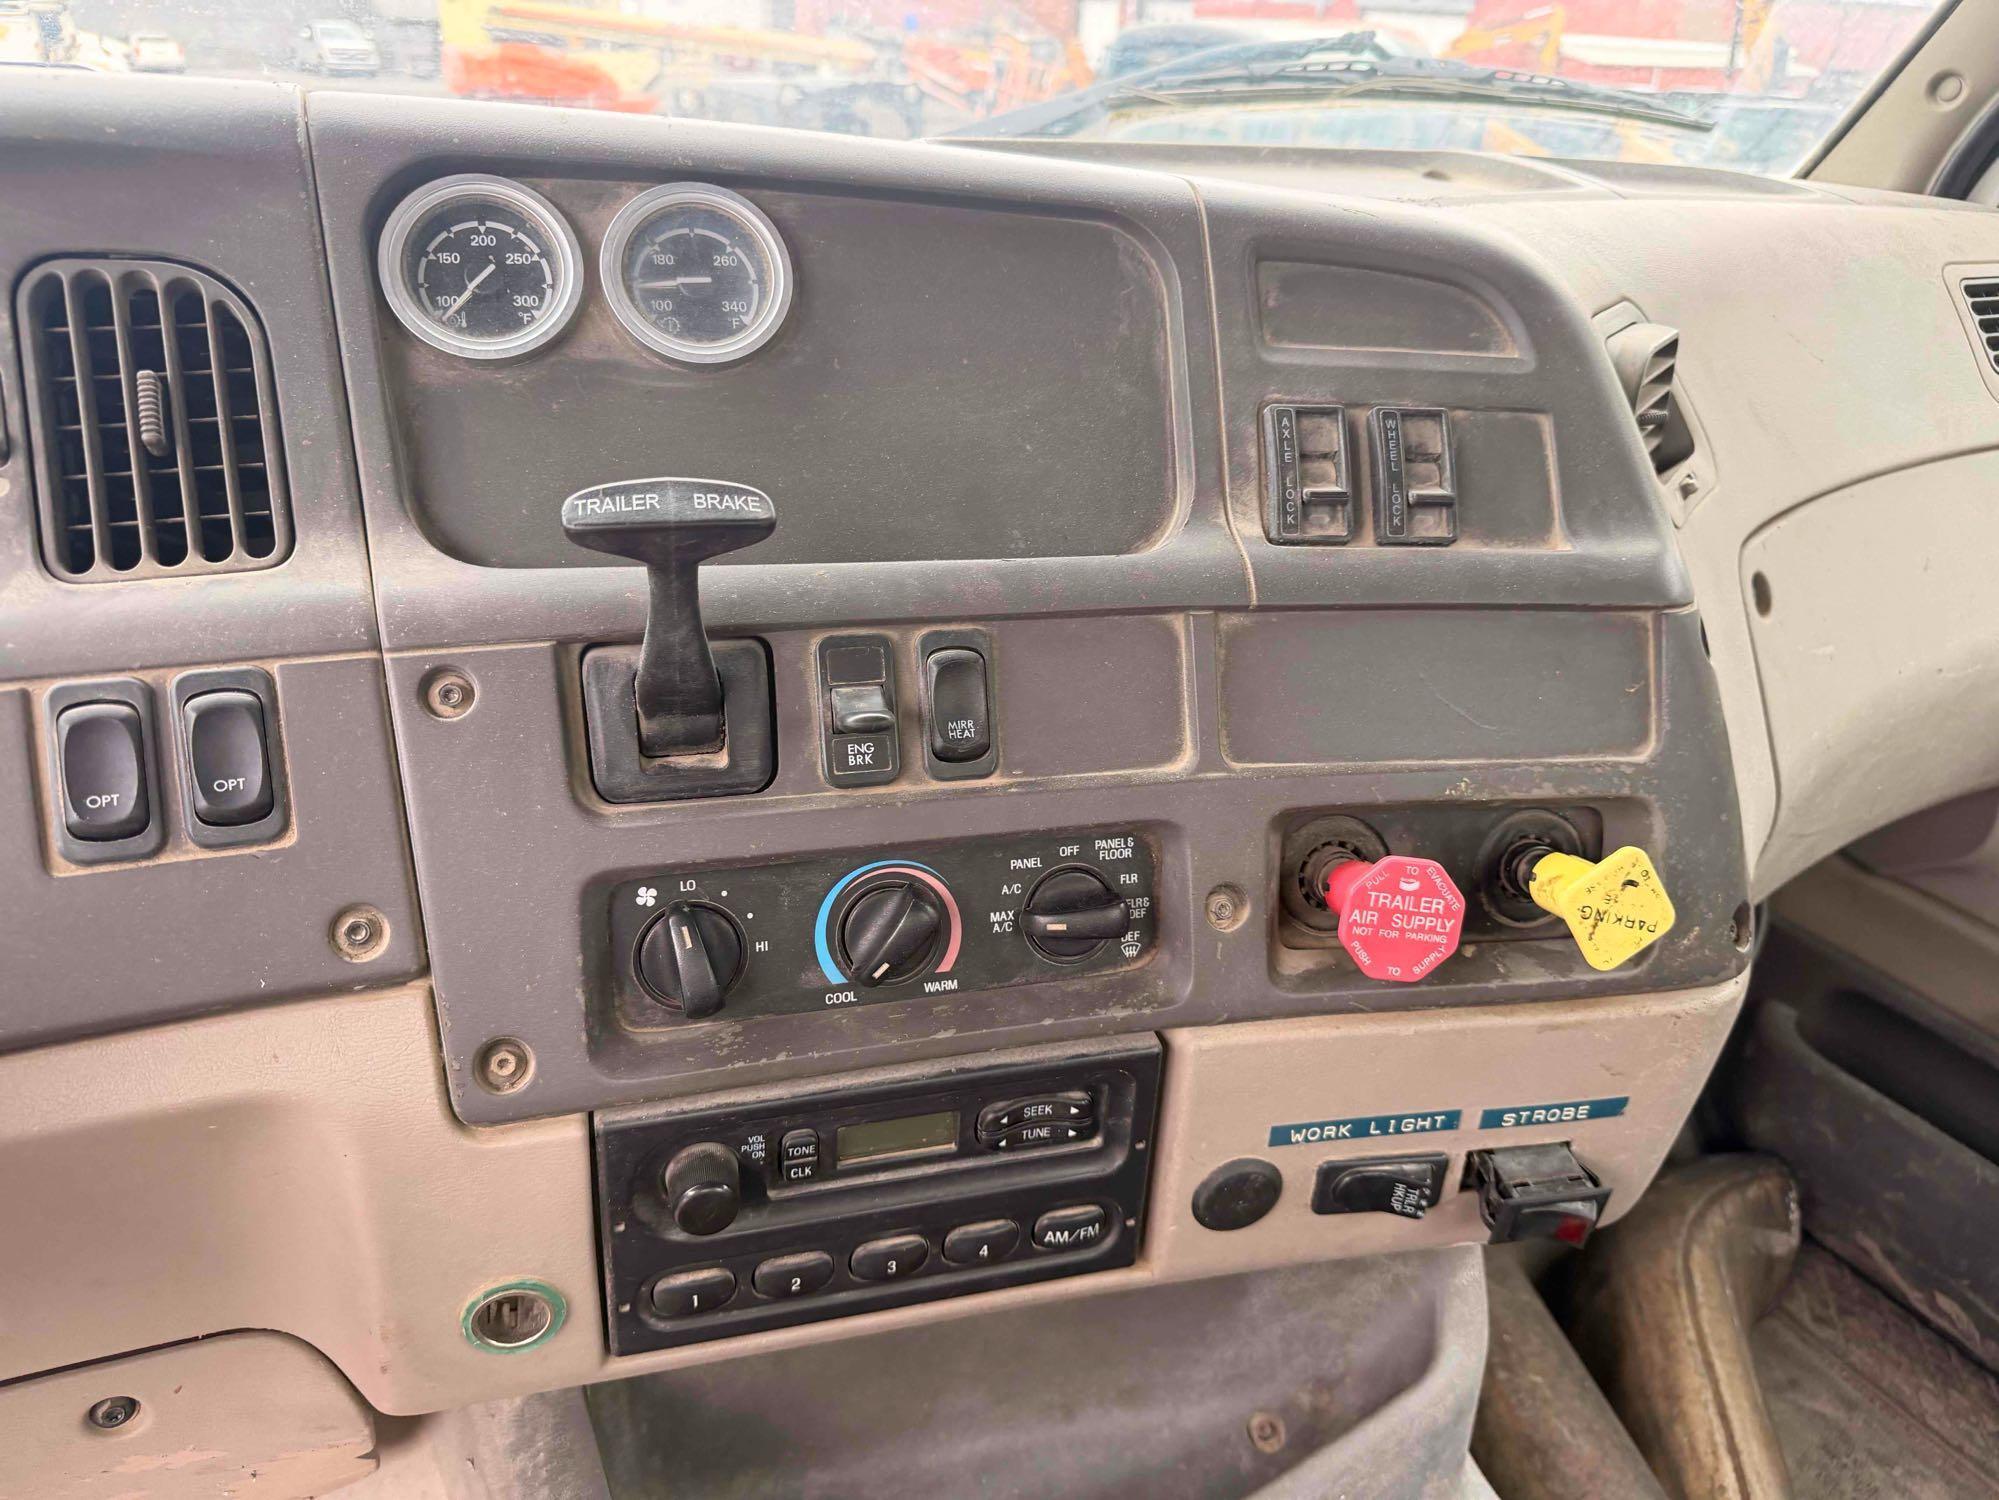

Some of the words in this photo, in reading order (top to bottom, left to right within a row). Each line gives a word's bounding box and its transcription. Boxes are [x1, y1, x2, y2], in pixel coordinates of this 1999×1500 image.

[470, 235, 497, 247] 200
[437, 252, 460, 264] 150
[505, 253, 531, 265] 250
[652, 254, 674, 265] 180
[713, 256, 738, 267] 260
[436, 295, 460, 307] 100
[513, 295, 539, 307] 300
[651, 300, 673, 311] 100
[722, 301, 747, 313] 340
[1281, 417, 1293, 463] AXLE
[1385, 419, 1399, 472] WHEEL
[1392, 483, 1401, 527] LOCK
[574, 494, 660, 516] TRAILER
[693, 493, 763, 512] BRAKE
[1286, 477, 1296, 525] LOCK
[948, 720, 974, 730] MIRR
[948, 729, 976, 739] HEAT
[847, 743, 875, 755] ENG
[848, 754, 874, 766] BRK
[213, 777, 246, 793] OPT
[86, 794, 120, 809] OPT
[1095, 838, 1126, 850] PANEL
[1059, 845, 1080, 857] OFF
[1099, 849, 1132, 861] FLOOR
[1010, 858, 1042, 870] PANEL
[1120, 874, 1138, 885] FLR
[1365, 870, 1390, 889] PULL
[1406, 865, 1420, 875] TO
[680, 880, 696, 892] LO
[1001, 884, 1022, 895] A/C
[1368, 891, 1446, 915] TRAILER
[990, 910, 1015, 923] MAX
[1349, 909, 1379, 925] AIR
[1392, 913, 1455, 933] SUPPLY
[1579, 905, 1658, 933] PARKING
[992, 921, 1013, 934] A/C
[1352, 926, 1373, 936] NOT
[1378, 929, 1399, 939] FOR
[1405, 931, 1448, 944] PARKING
[755, 941, 769, 953] HI
[1350, 941, 1372, 965] PUSH
[1387, 966, 1401, 976] TO
[1412, 946, 1447, 974] SUPPLY
[924, 979, 959, 994] WARM
[825, 991, 857, 1005] COOL
[1023, 1104, 1053, 1117] SEEK
[1501, 1105, 1590, 1127] STROBE
[1022, 1127, 1051, 1140] TUNE
[1290, 1123, 1352, 1143] WORK
[1369, 1115, 1446, 1135] LIGHT
[748, 1135, 765, 1143] VOL
[741, 1142, 765, 1152] PUSH
[788, 1144, 816, 1157] TONE
[752, 1150, 765, 1159] ON
[790, 1165, 812, 1178] CLK
[1402, 1188, 1420, 1213] TRLR
[1044, 1223, 1100, 1244] AM/FM
[979, 1244, 989, 1258] 4
[887, 1260, 897, 1274] 3
[791, 1277, 801, 1290] 2
[691, 1294, 699, 1307] 1
